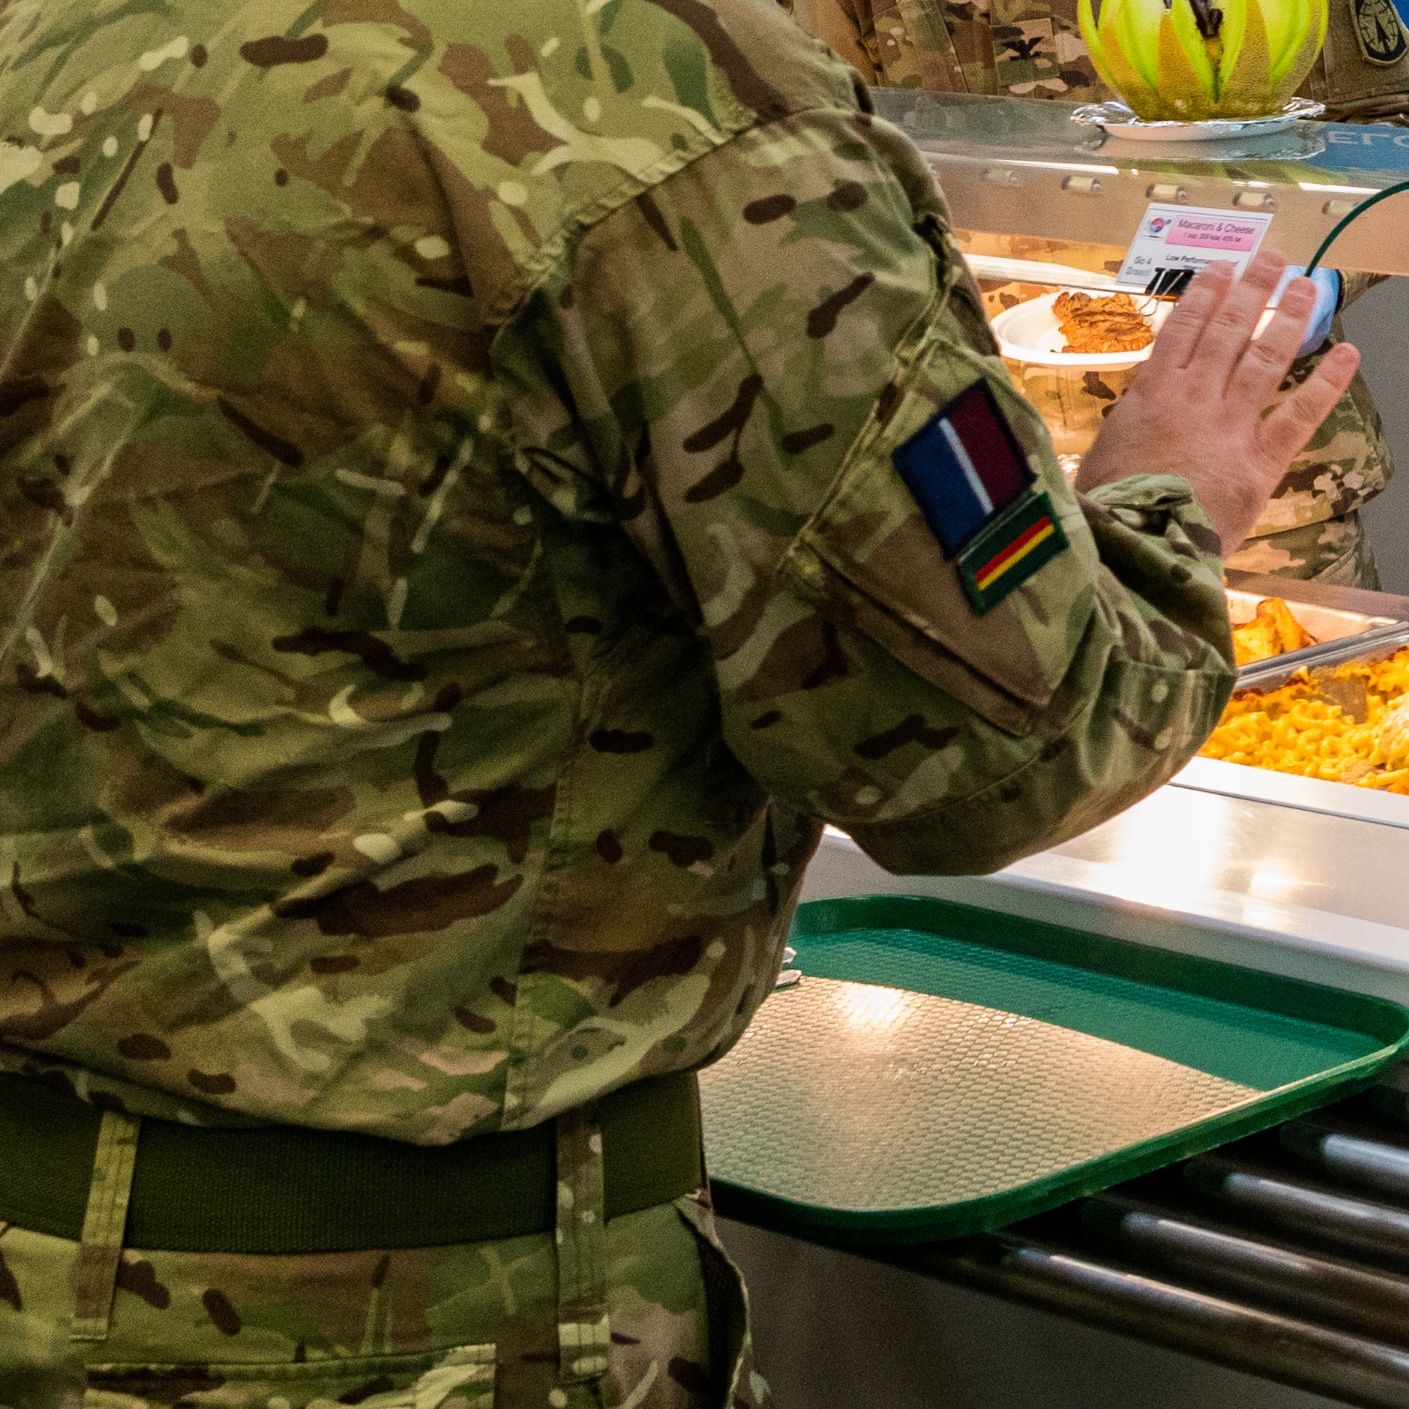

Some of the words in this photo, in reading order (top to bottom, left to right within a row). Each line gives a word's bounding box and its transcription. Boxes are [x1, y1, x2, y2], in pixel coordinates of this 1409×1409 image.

[1178, 218, 1214, 232] Macaroni
[1215, 222, 1223, 232] &
[1223, 222, 1256, 235] Cheese
[1165, 253, 1179, 262] Low
